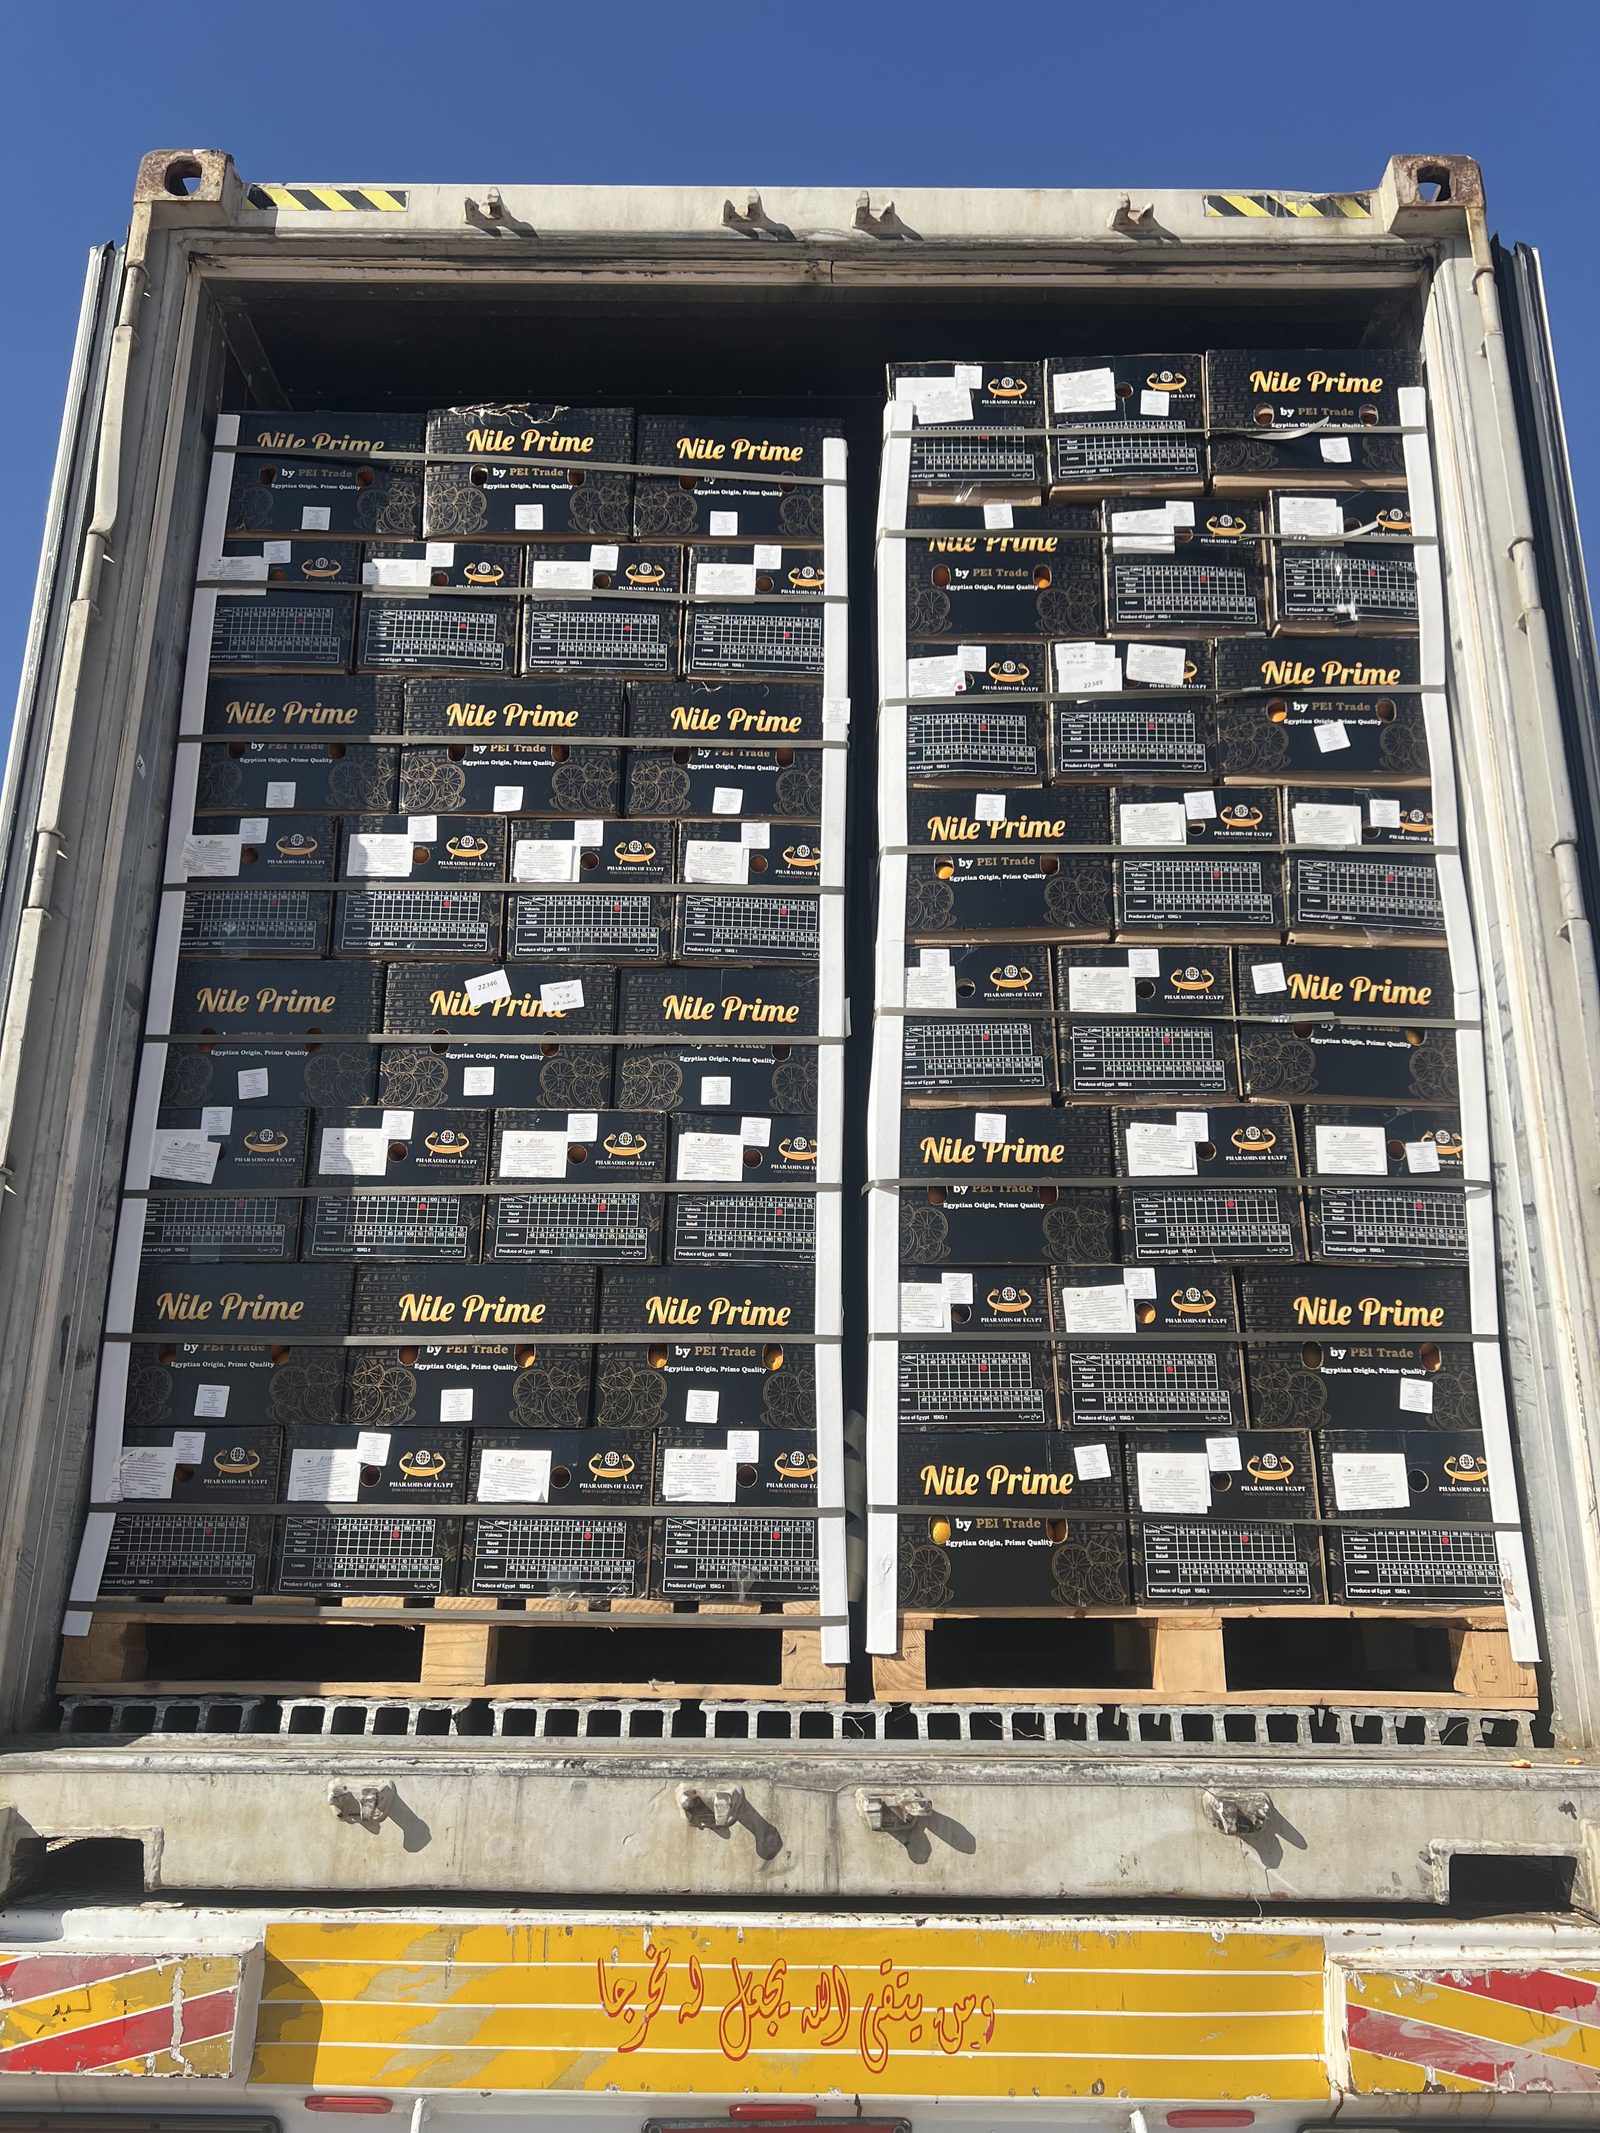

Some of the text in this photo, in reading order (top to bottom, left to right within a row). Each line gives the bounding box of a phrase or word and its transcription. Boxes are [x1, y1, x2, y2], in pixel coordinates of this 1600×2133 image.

[1249, 370, 1383, 394] Nile Prime
[1280, 407, 1294, 417] by
[1321, 408, 1354, 416] Trade
[257, 431, 384, 451] Nile Prime
[466, 429, 593, 454] Nile Prime
[676, 437, 803, 463] Nile Prime
[282, 468, 352, 478] by PEI Trade
[493, 468, 564, 478] by PEI Trade
[956, 568, 1028, 579] by PEI Trade
[1260, 660, 1401, 688] Nile Prime
[227, 701, 356, 725] Nile Prime
[446, 703, 577, 728] Nile Prime
[671, 706, 801, 734] Nile Prime
[1293, 702, 1370, 712] by PEI Trade
[927, 815, 1066, 842] Nile Prime
[958, 857, 1035, 868] by PEI Trade
[196, 987, 336, 1014] Nile Prime
[1286, 972, 1432, 1006] Nile Prime
[662, 994, 800, 1024] Nile Prime
[920, 1136, 1064, 1164] Nile Prime
[157, 1291, 304, 1321] Nile Prime
[399, 1292, 545, 1324] Nile Prime
[645, 1295, 790, 1327] Nile Prime
[1292, 1296, 1445, 1328] Nile Prime
[675, 1345, 756, 1357] by PEI Trade
[1330, 1347, 1413, 1358] by PEI Trade
[920, 1464, 1073, 1496] Nile Prime
[955, 1518, 1041, 1531] by PEI Trade
[718, 1957, 790, 2062] يجعل
[801, 1964, 850, 2046] الله
